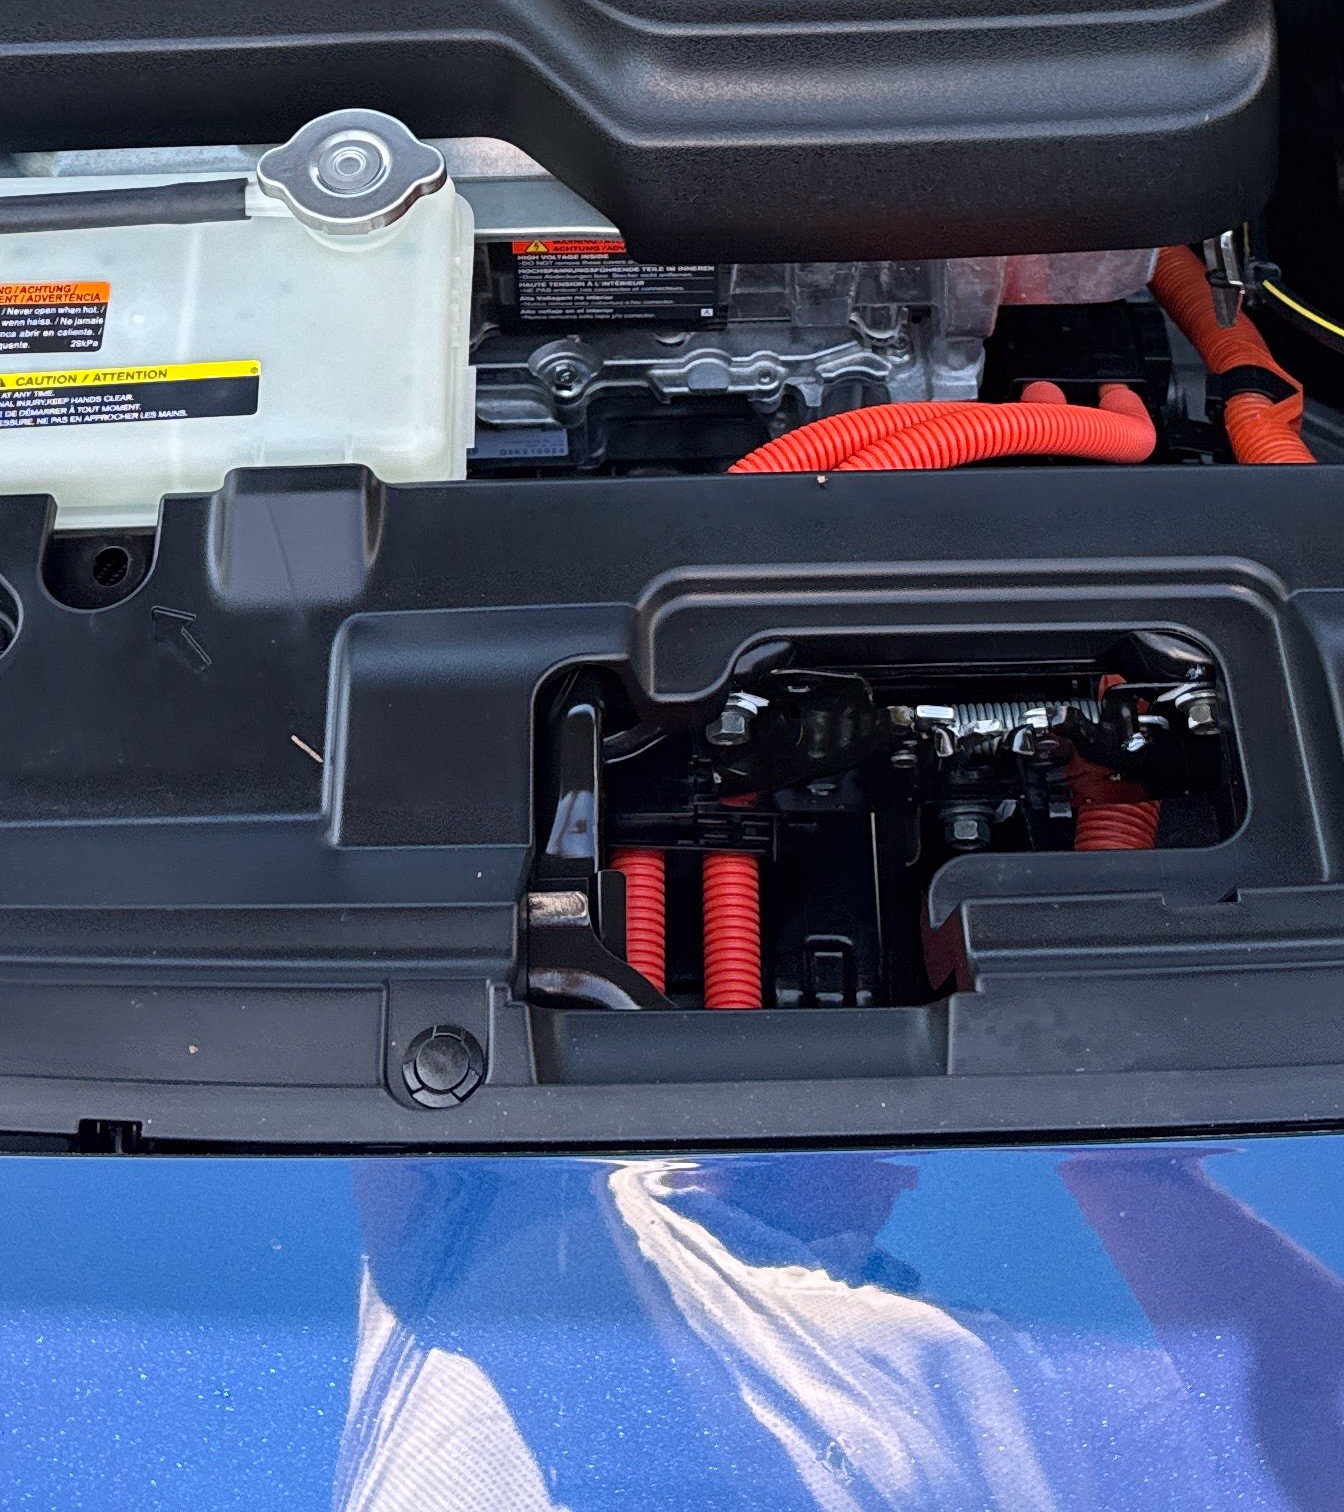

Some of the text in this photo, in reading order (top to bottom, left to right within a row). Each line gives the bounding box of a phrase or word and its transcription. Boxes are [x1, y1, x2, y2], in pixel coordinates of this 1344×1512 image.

[20, 285, 71, 294] ACHTUNG
[34, 307, 56, 316] open
[57, 306, 81, 314] when
[19, 329, 41, 338] abrir
[16, 374, 77, 386] CAUTION
[92, 369, 168, 382] ATTENTION
[70, 395, 102, 404] HANDS
[103, 394, 134, 402] CLEAR.
[77, 406, 100, 414] TOUT
[36, 417, 48, 425] NE
[50, 416, 68, 424] PAS
[84, 412, 139, 422] APPROCHER
